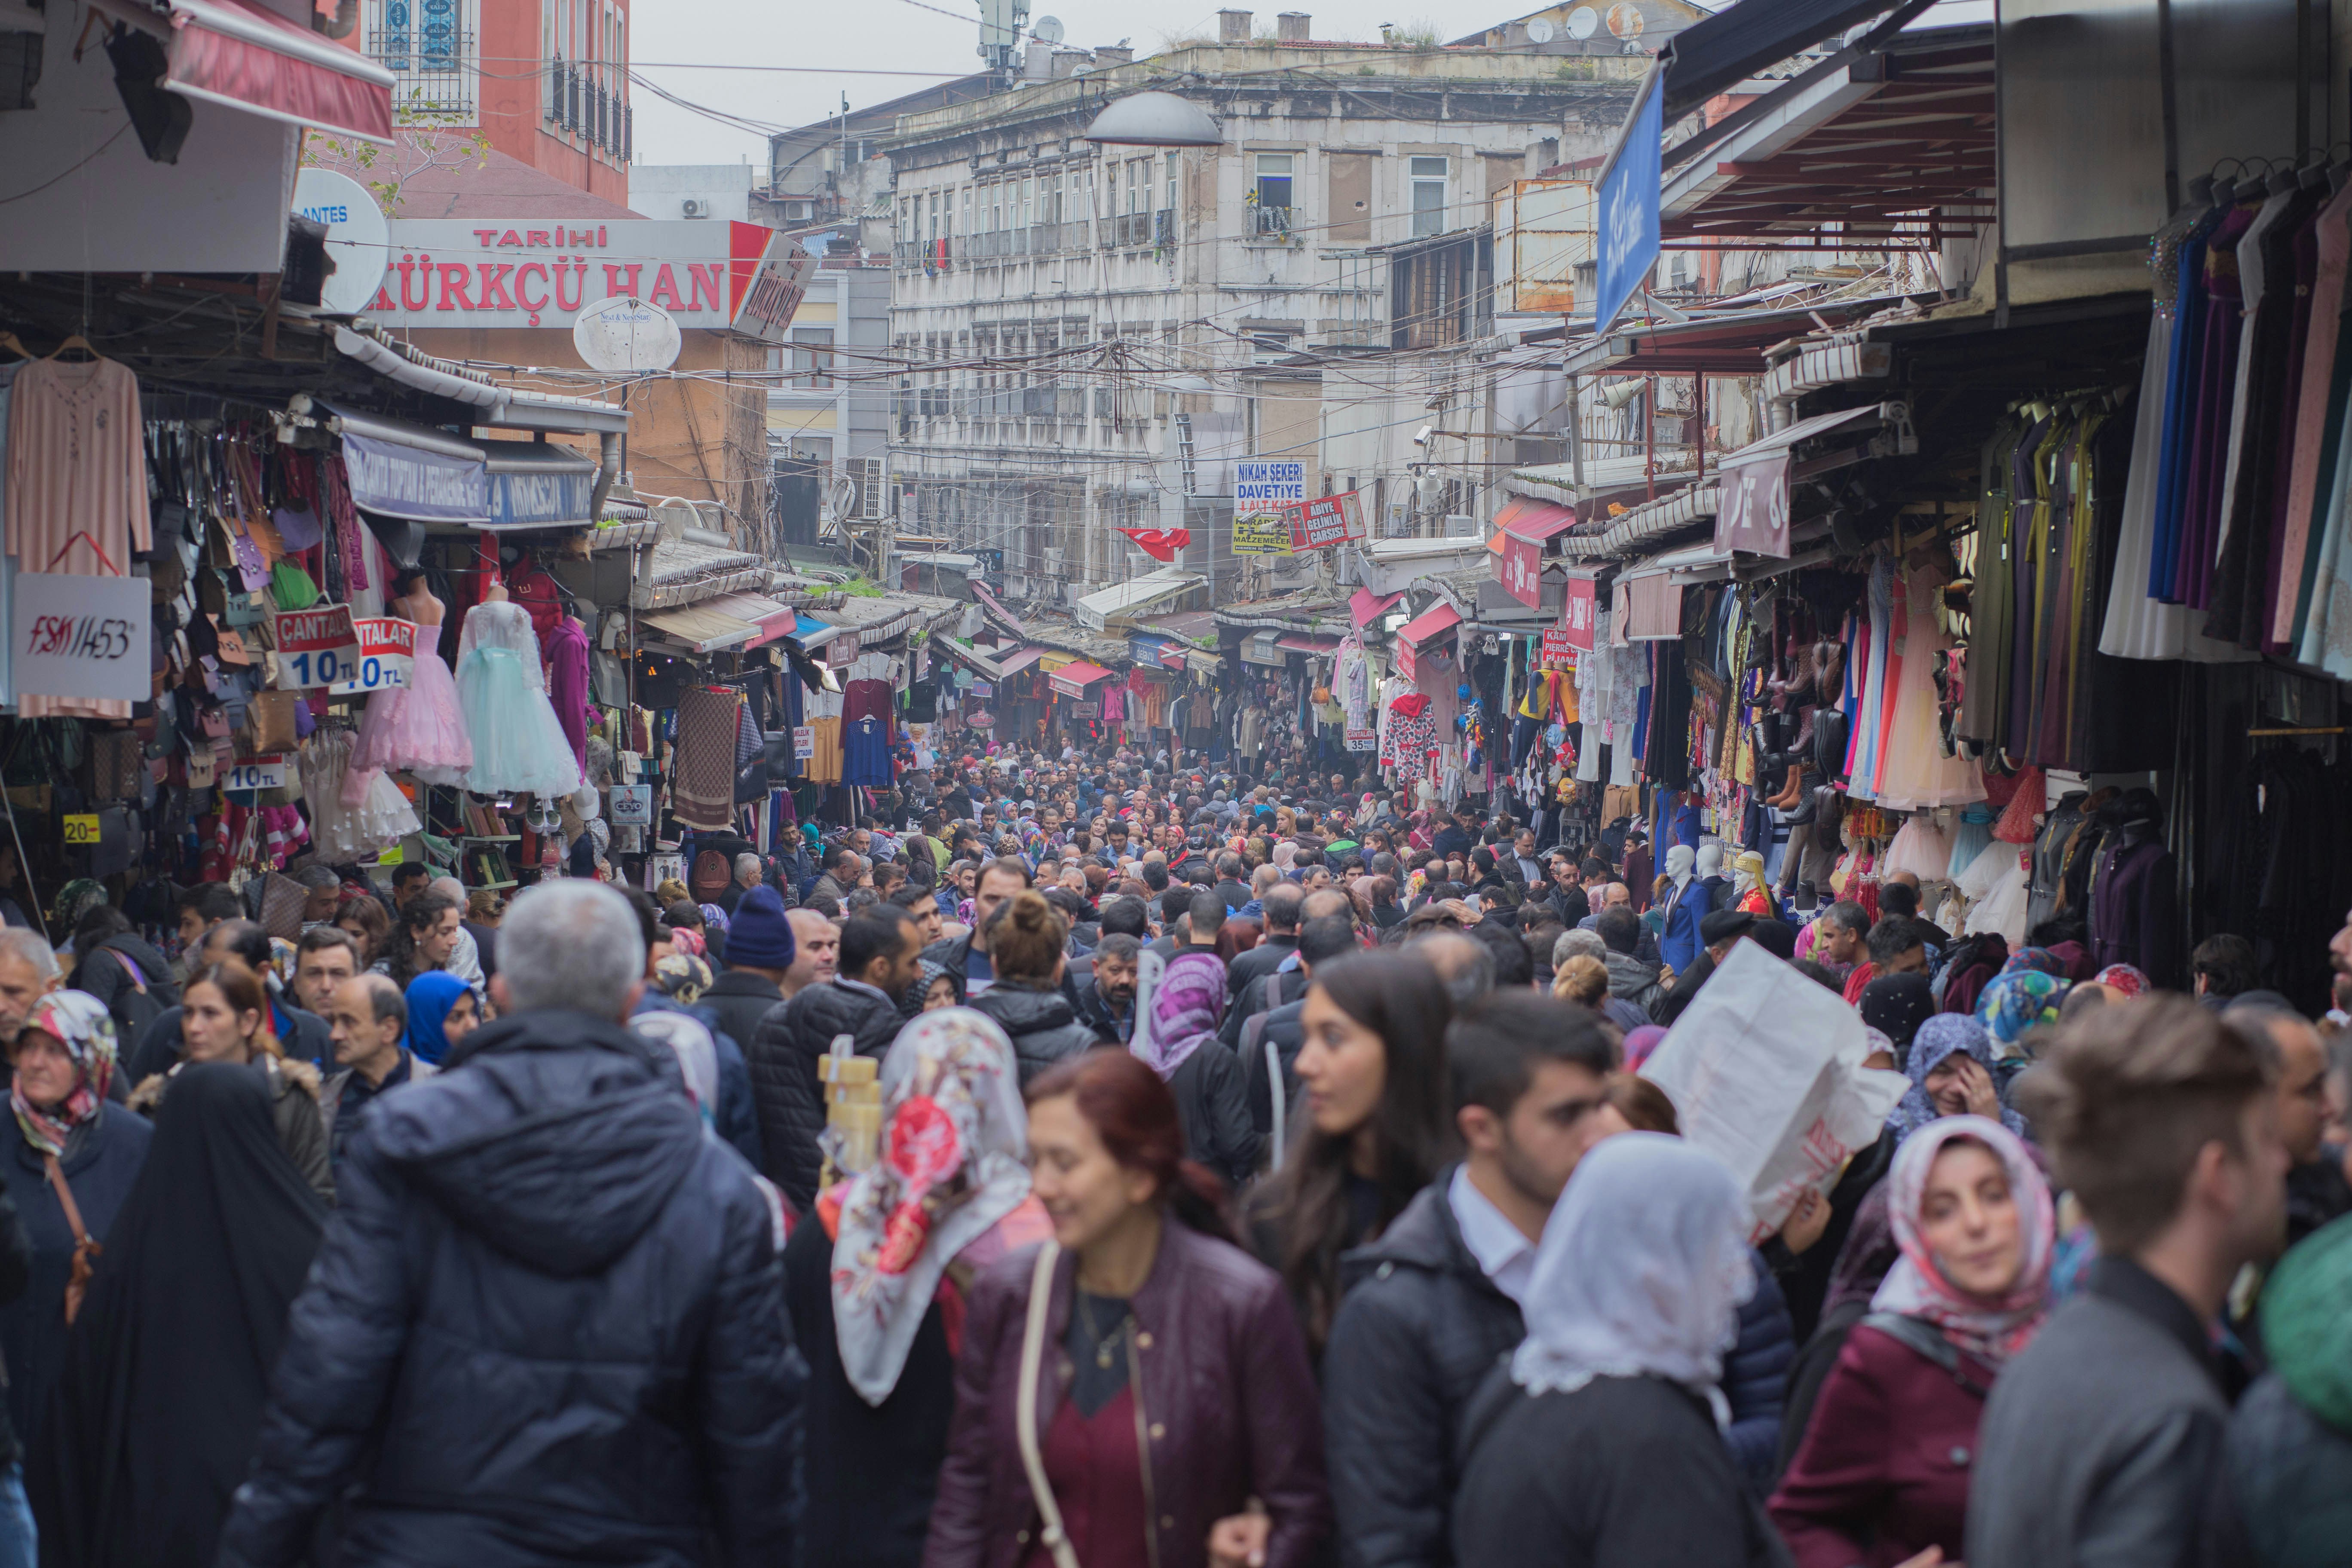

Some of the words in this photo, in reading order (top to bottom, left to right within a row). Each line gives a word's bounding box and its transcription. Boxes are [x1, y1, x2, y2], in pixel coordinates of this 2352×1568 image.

[473, 225, 606, 247] TARİHİ
[603, 263, 724, 312] HAN
[601, 312, 614, 321] Next
[1238, 464, 1267, 482] NİKAH
[1270, 464, 1302, 484] ŞEKERİ
[1238, 484, 1302, 499] DAVETİYE
[1249, 500, 1268, 513] ALT
[1310, 501, 1335, 517] ABİYE
[1307, 513, 1344, 531] GELİNLİK
[1310, 526, 1345, 545] ÇARŞISI
[354, 623, 411, 647] NTALAR
[1136, 646, 1155, 662] dejavu
[1545, 643, 1569, 653] PIERRE
[292, 651, 337, 685] 10
[340, 663, 356, 679] TL
[383, 669, 402, 685] TL
[1348, 731, 1373, 739] ÇANTALAR
[1352, 740, 1363, 750] 35
[230, 766, 260, 787] 10
[262, 775, 277, 786] TL
[66, 822, 88, 840] 20
